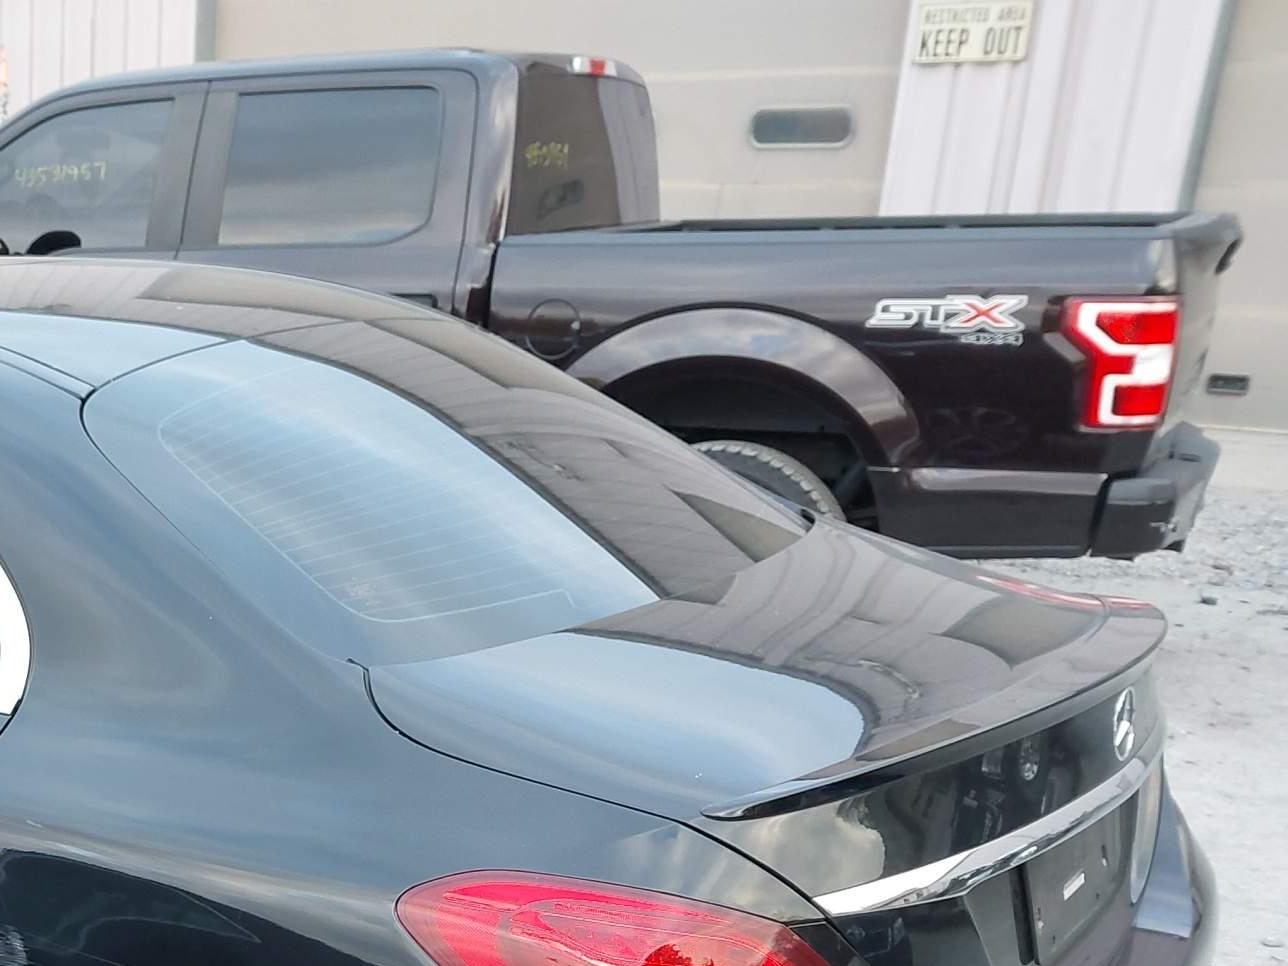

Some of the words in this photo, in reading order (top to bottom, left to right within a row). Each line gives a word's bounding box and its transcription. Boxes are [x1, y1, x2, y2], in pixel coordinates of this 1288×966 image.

[923, 7, 991, 24] RESTRICTED
[997, 6, 1027, 21] AREA
[918, 28, 970, 57] KEEP
[983, 25, 1024, 55] OUT
[865, 294, 1029, 333] STX
